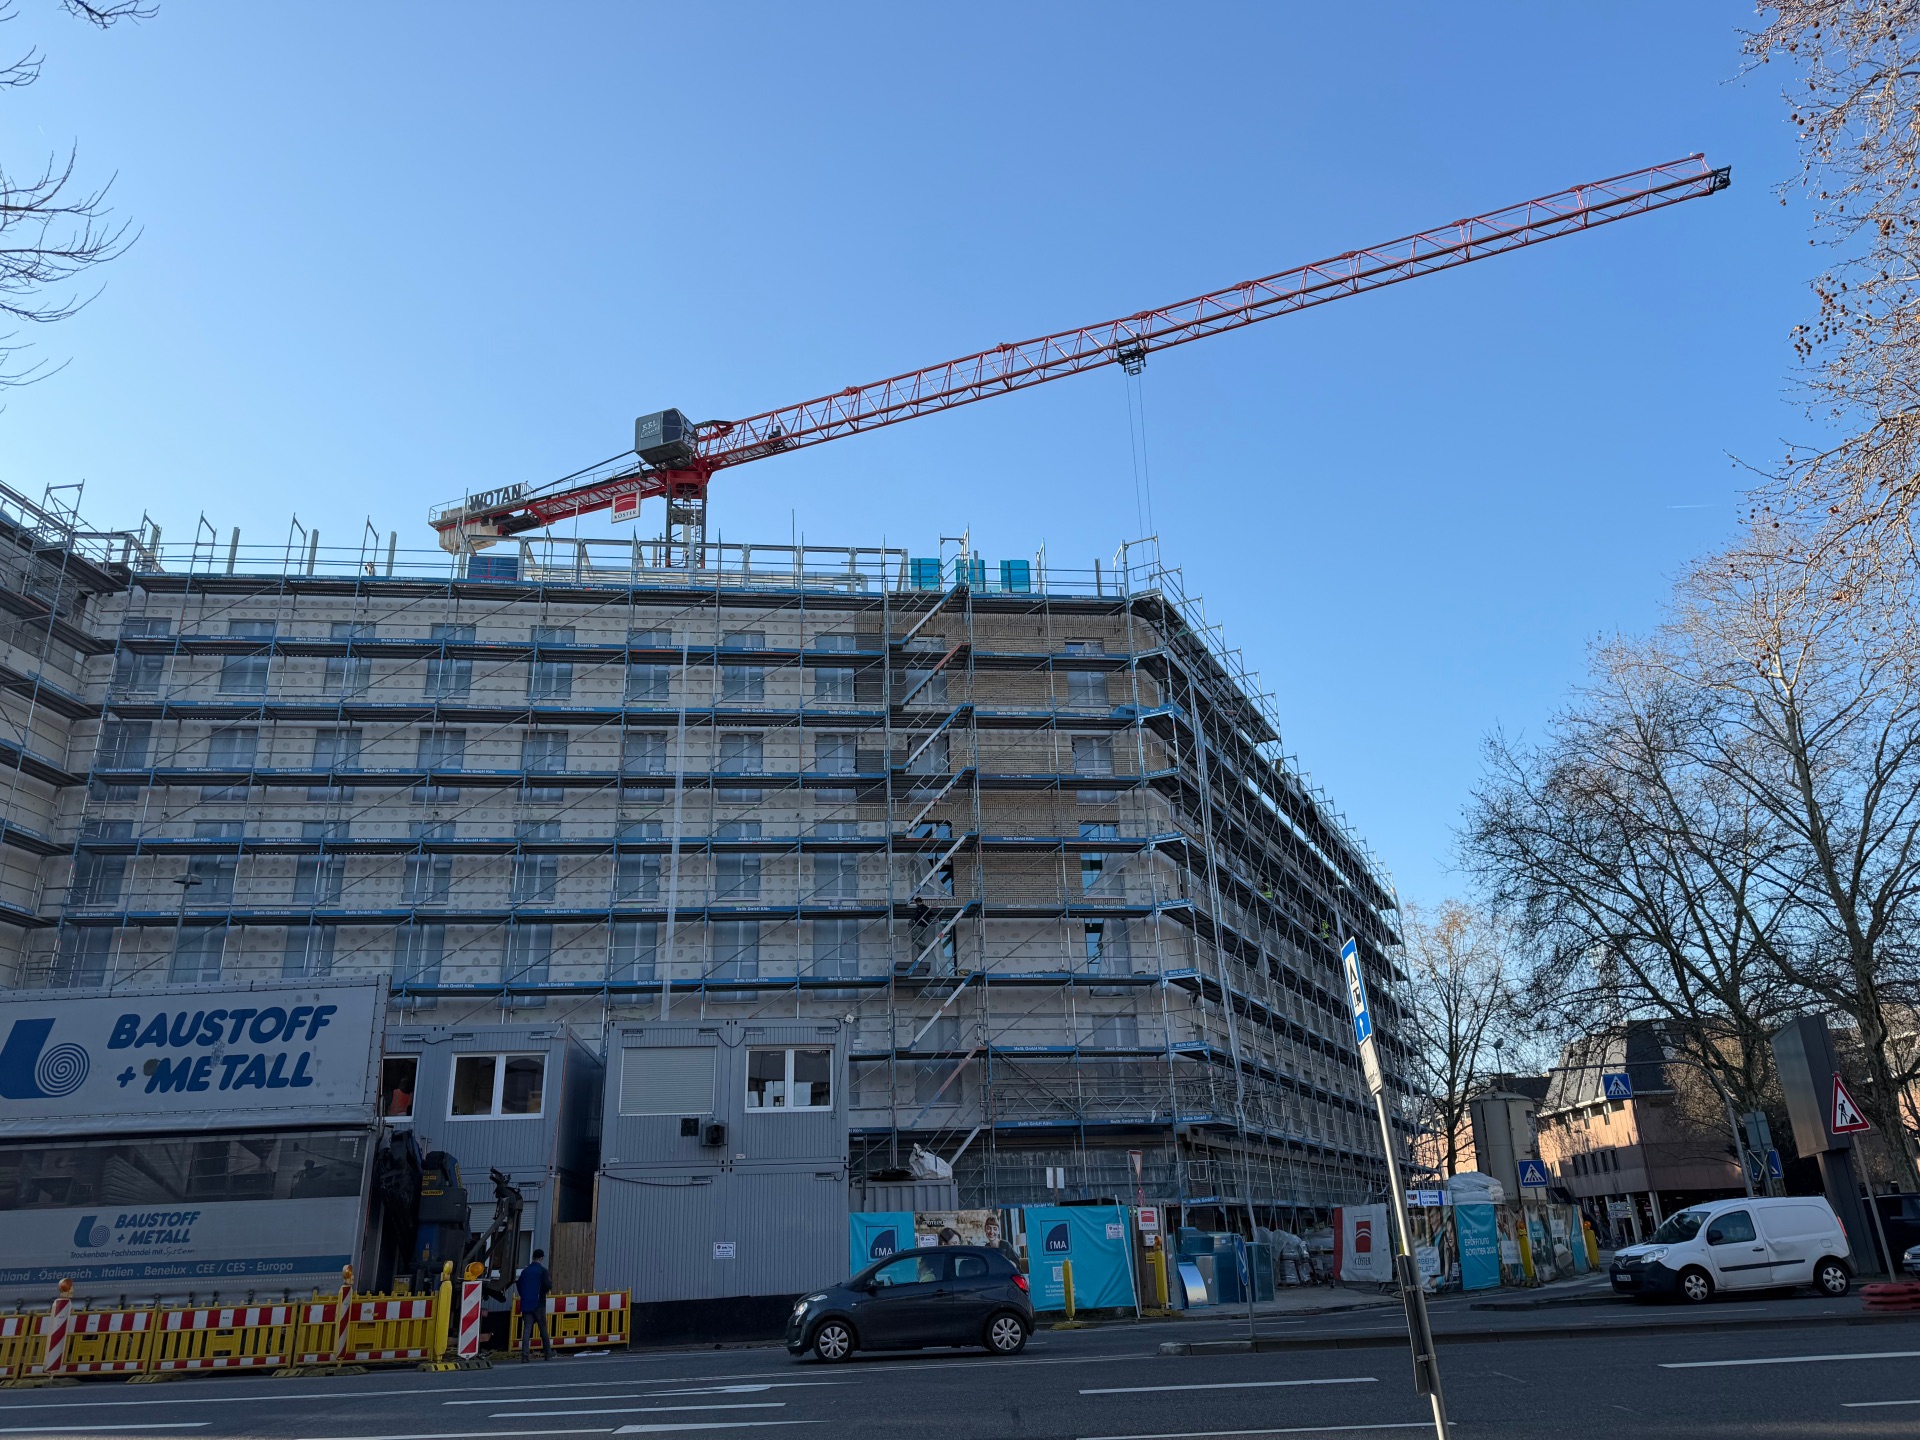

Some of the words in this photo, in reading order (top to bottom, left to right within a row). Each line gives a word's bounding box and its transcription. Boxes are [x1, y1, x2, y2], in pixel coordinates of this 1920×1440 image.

[469, 482, 522, 510] WOTAN
[614, 510, 637, 520] KÖSTER
[107, 1004, 338, 1050] BAUSTOFF
[116, 1066, 136, 1088] +
[144, 1051, 314, 1094] METALL
[114, 1211, 201, 1229] BAUSTOFF
[128, 1230, 191, 1246] METALL
[70, 1248, 150, 1260] Trockenbau-Fachhandel
[152, 1248, 164, 1256] mit
[1466, 1247, 1486, 1256] SOMMER
[1354, 1256, 1372, 1266] KÖSTER
[39, 1268, 92, 1281] Österreich
[102, 1266, 134, 1278] Italien
[144, 1264, 186, 1276] Benelux
[196, 1263, 214, 1274] CEE
[226, 1262, 246, 1272] CES
[256, 1261, 294, 1274] Europa
